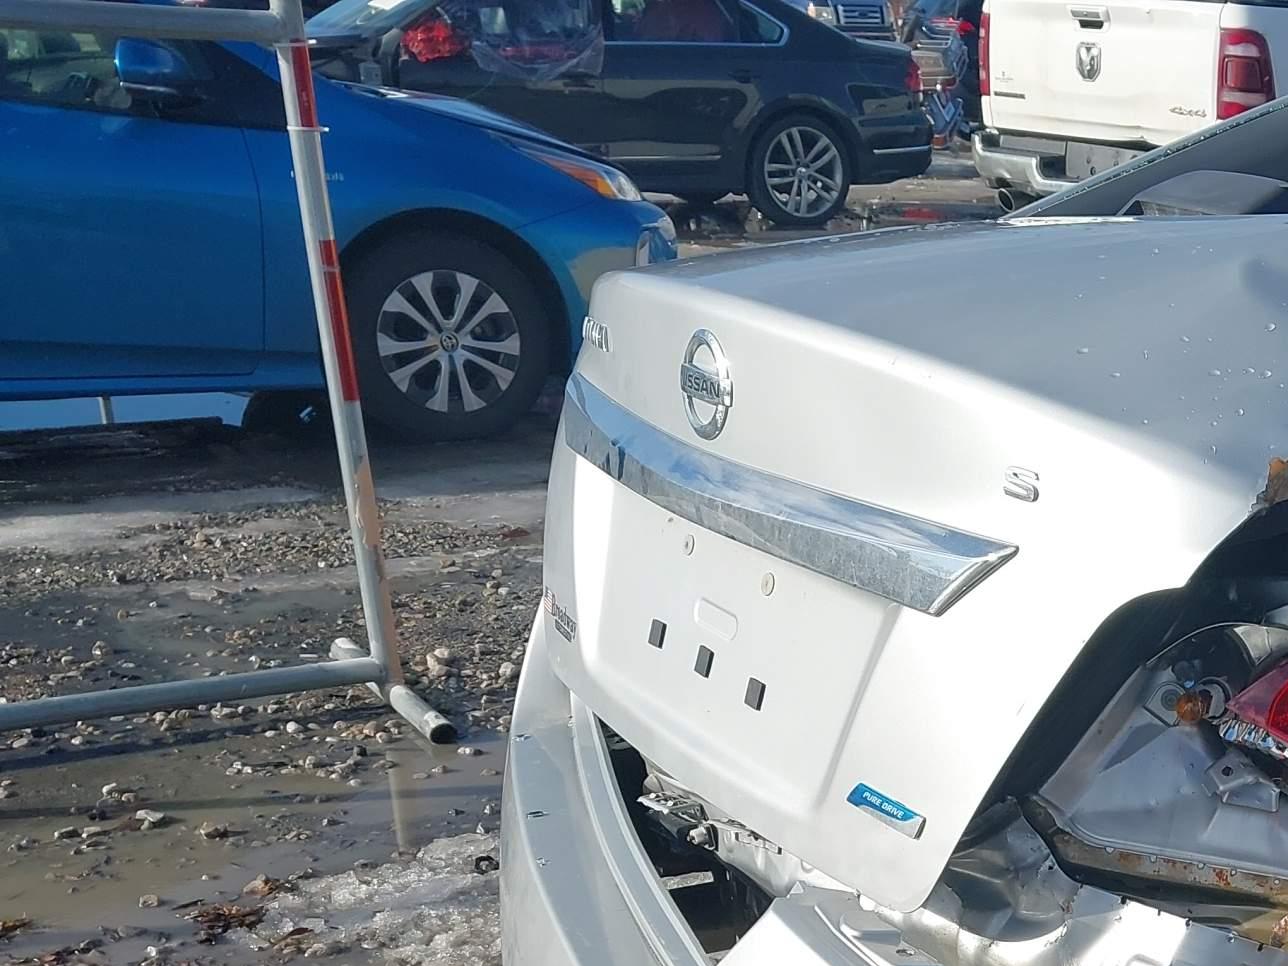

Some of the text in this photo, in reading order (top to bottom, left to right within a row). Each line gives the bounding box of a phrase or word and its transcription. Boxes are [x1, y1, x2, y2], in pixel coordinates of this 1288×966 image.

[1003, 465, 1039, 502] S
[862, 791, 904, 819] PURE DRIVE
